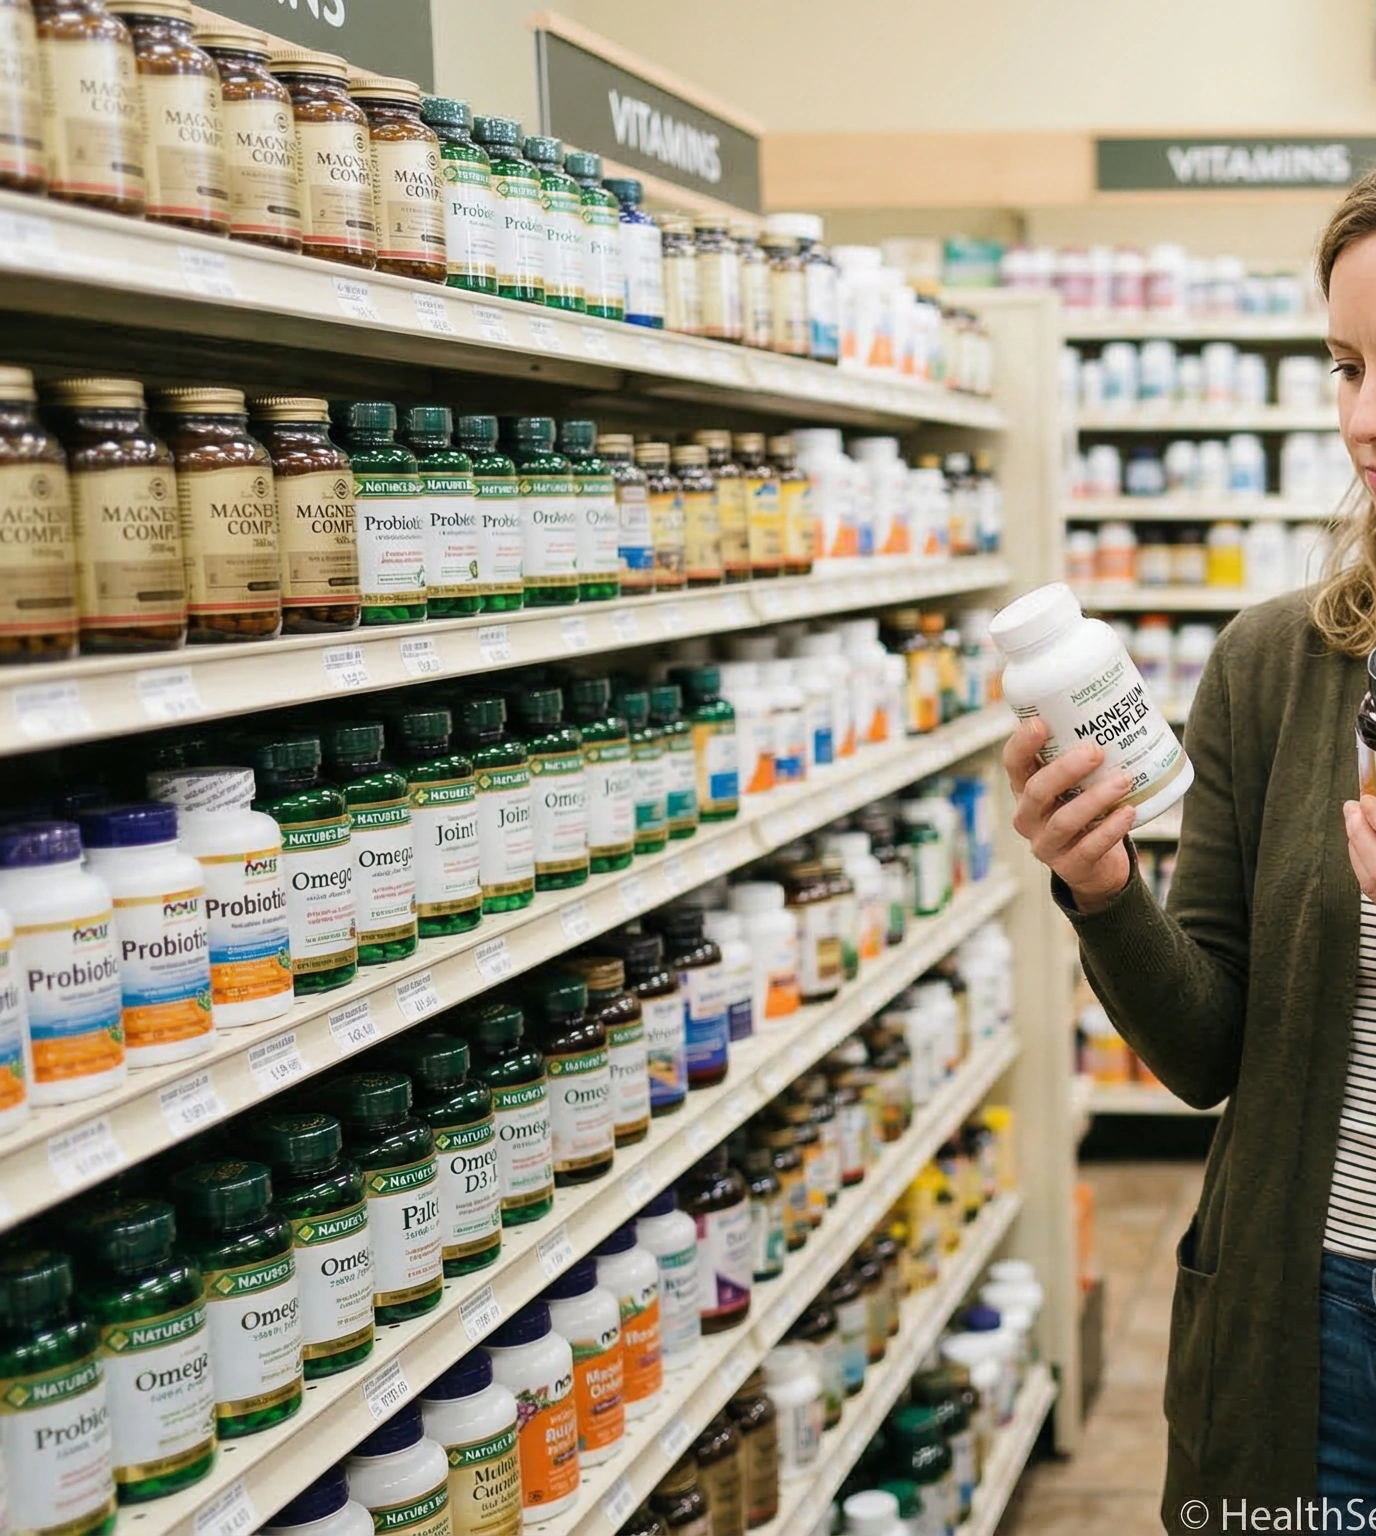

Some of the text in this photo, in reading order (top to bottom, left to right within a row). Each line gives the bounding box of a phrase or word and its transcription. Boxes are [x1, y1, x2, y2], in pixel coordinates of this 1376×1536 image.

[608, 89, 721, 184] VITAMINS
[1167, 145, 1351, 183] VITAMINS
[1073, 683, 1145, 740] MAGNESIUM
[1094, 698, 1150, 747] COMPLEX
